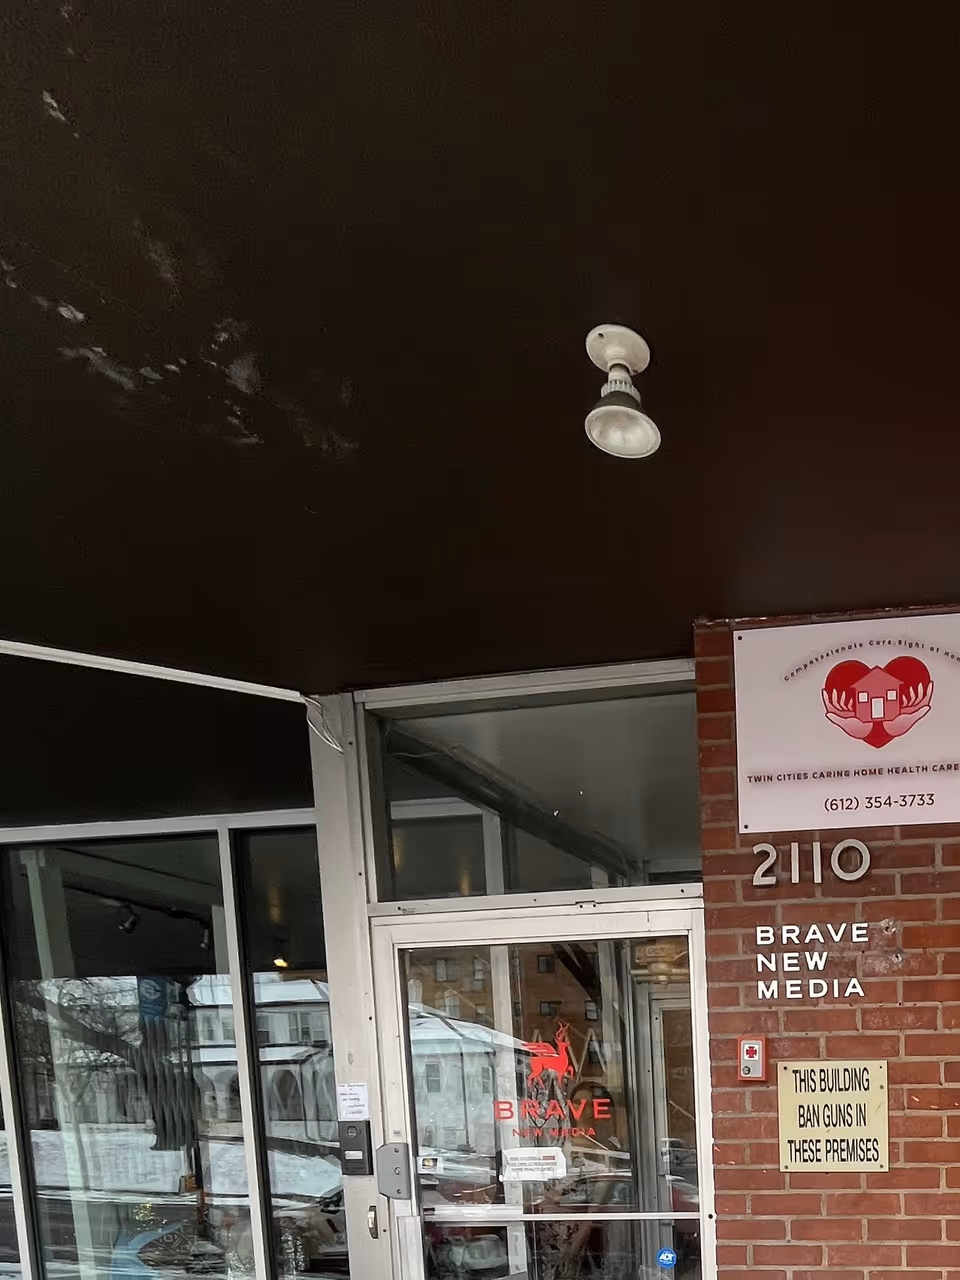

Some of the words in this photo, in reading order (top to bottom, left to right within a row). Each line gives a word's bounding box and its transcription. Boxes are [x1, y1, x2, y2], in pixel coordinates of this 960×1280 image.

[747, 774, 773, 784] TWIN
[776, 771, 808, 782] CITIES
[812, 769, 850, 780] CARING
[853, 767, 884, 777] HOME
[887, 765, 929, 775] HEALTH
[932, 763, 960, 772] CARE
[824, 796, 860, 812] (612)
[865, 793, 936, 809] 354-3733
[752, 838, 871, 886] 2110
[756, 922, 869, 945] BRAVE
[756, 951, 828, 973] NEW
[757, 978, 865, 1000] MEDIA
[792, 1069, 817, 1093] THIS
[819, 1067, 870, 1093] BUILDING
[492, 1098, 612, 1120] BRAVE
[798, 1104, 820, 1128] BAN
[822, 1103, 853, 1128] GUNS
[855, 1103, 867, 1127] IN
[512, 1128, 543, 1138] NEW
[549, 1127, 596, 1137] MEDIA
[787, 1139, 822, 1163] THESE
[825, 1138, 880, 1163] PREMISES
[659, 1252, 675, 1262] ADT
